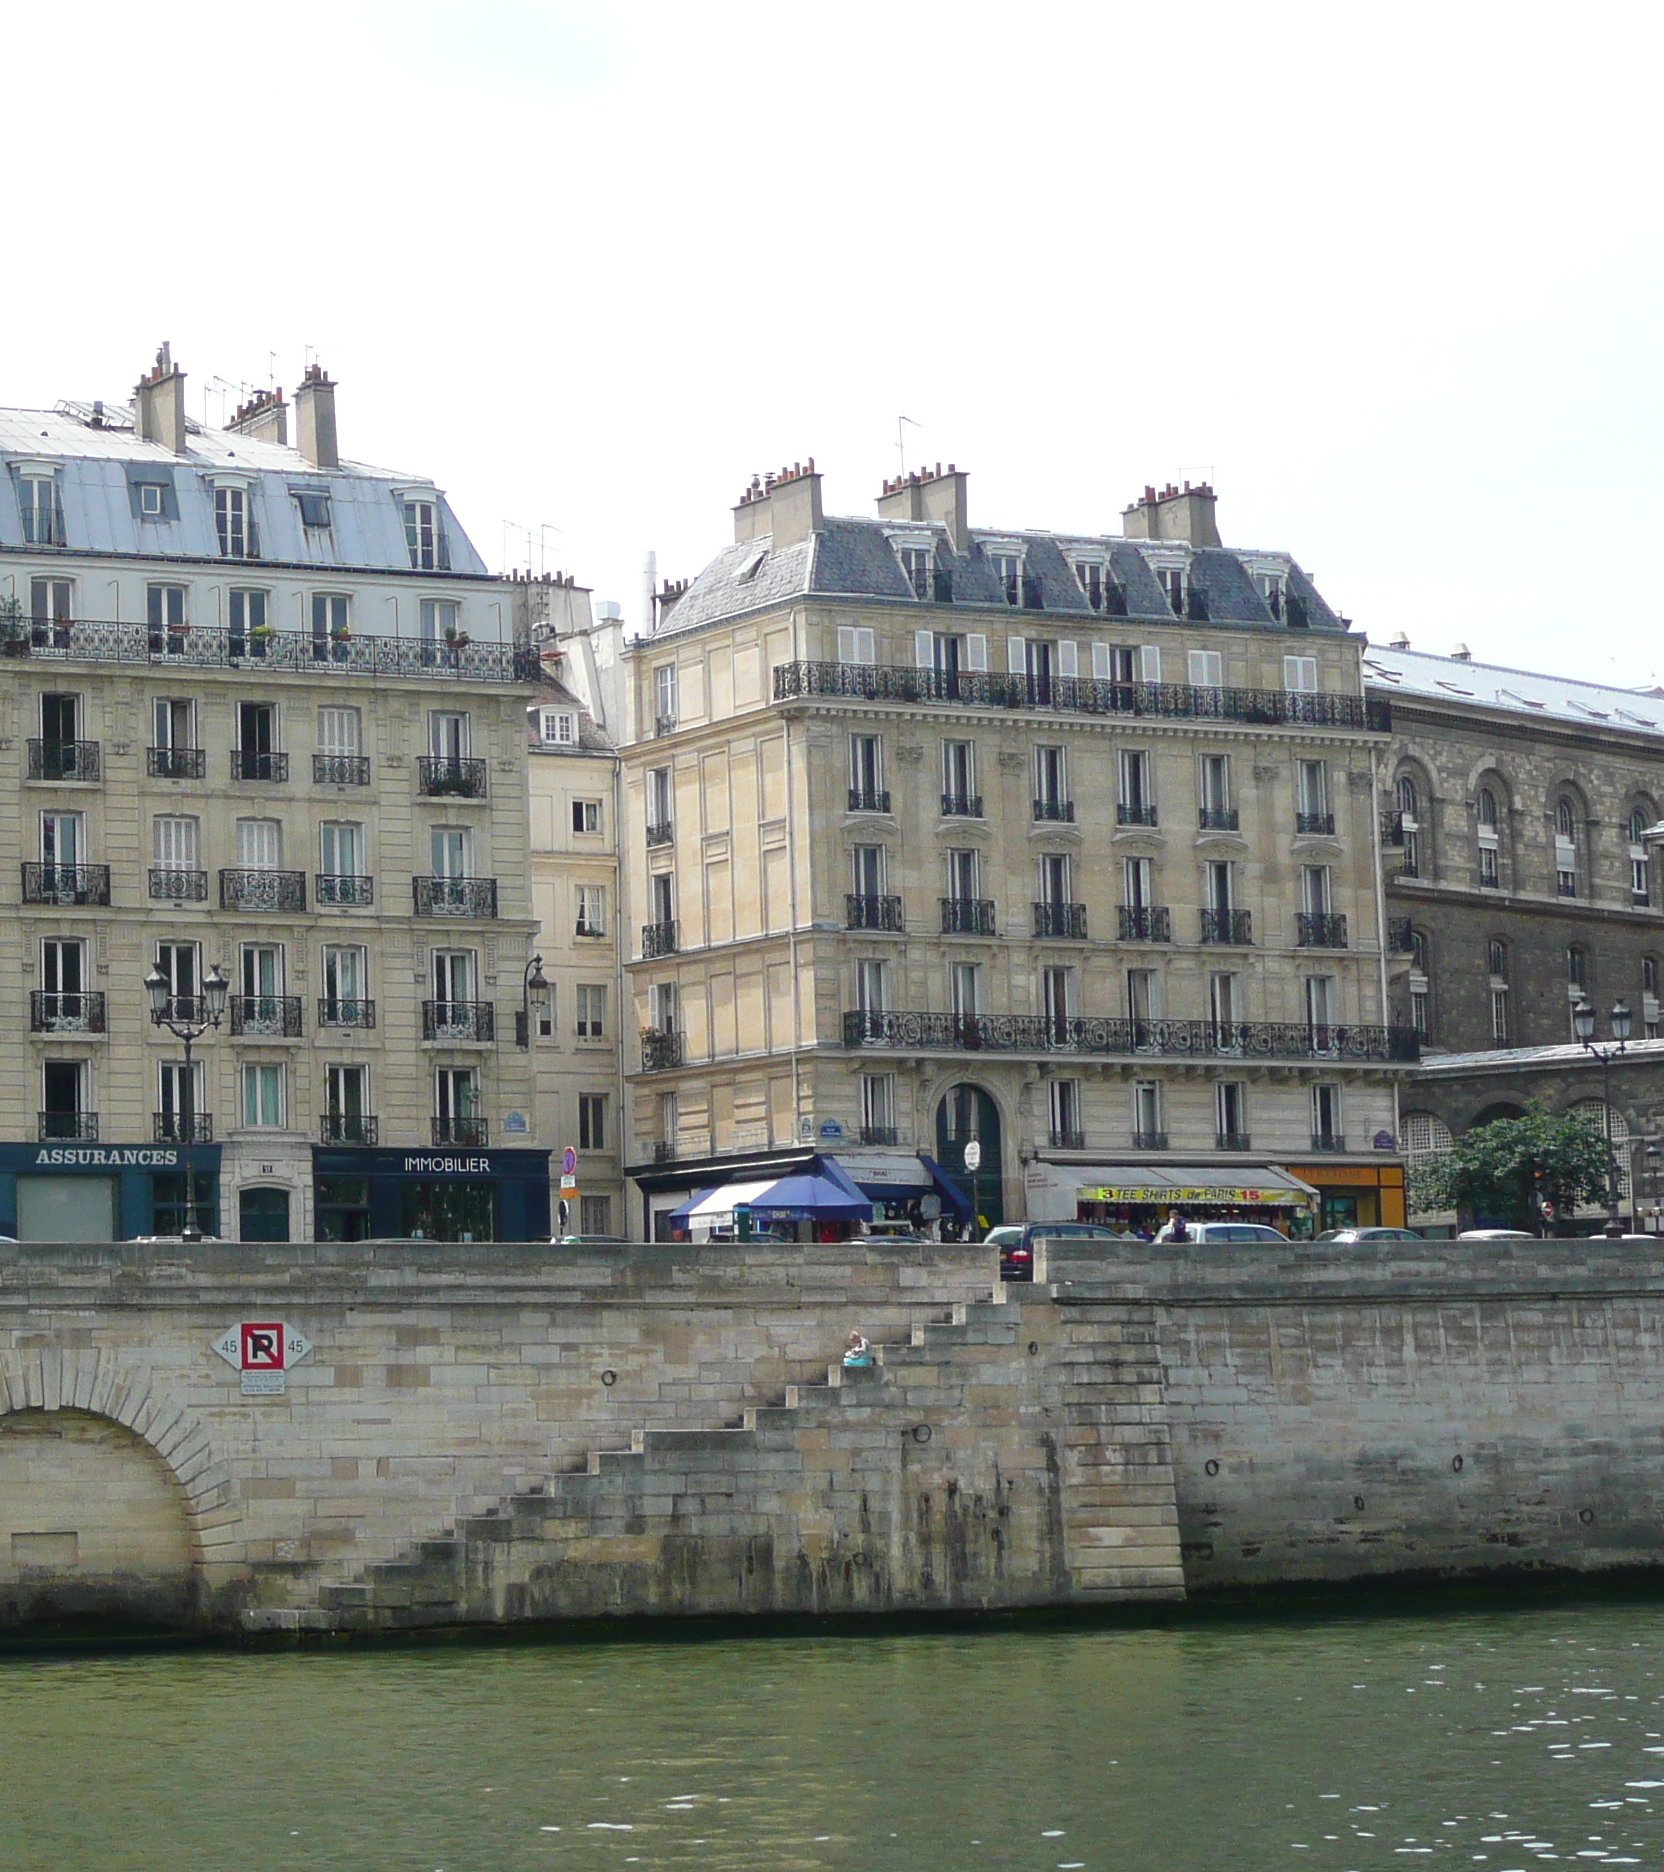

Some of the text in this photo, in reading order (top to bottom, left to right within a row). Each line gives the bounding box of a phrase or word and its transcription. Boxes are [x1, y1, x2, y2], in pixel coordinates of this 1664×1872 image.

[35, 1149, 178, 1166] ASSURANCES
[405, 1157, 491, 1173] IMMOBILIER
[1102, 1189, 1115, 1199] 3
[1117, 1189, 1138, 1200] TEE
[1186, 1190, 1201, 1200] de
[1204, 1189, 1236, 1200] PARIS
[222, 1340, 238, 1353] 45
[288, 1340, 303, 1353] 45
